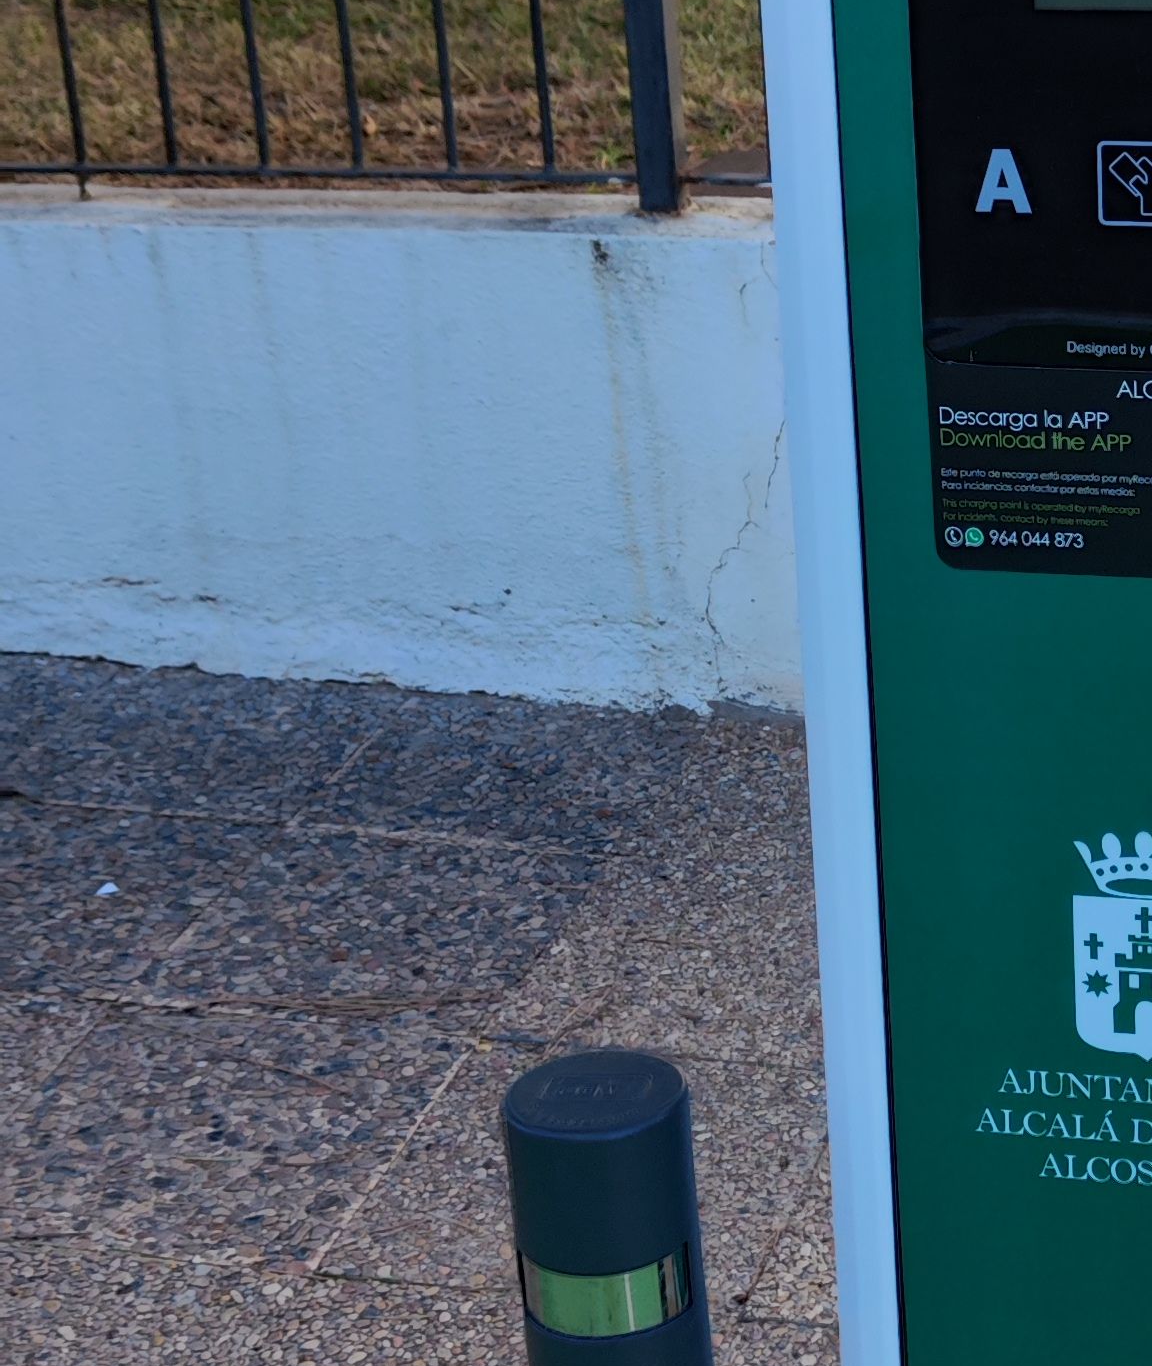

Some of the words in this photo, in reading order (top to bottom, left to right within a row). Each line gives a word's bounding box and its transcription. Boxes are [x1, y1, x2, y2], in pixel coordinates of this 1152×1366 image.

[973, 146, 1033, 215] A
[1066, 340, 1127, 357] Designed
[1130, 342, 1146, 359] by
[938, 406, 1039, 432] Descarga
[1043, 409, 1063, 429] la
[1067, 411, 1110, 430] APP
[938, 428, 1046, 450] Download
[1050, 431, 1086, 451] the
[1090, 433, 1132, 452] APP
[940, 467, 959, 478] Este
[960, 469, 987, 479] punto
[987, 469, 1001, 479] de
[1001, 471, 1039, 482] recarga
[1060, 473, 1101, 483] operado
[1101, 475, 1118, 485] por
[941, 480, 963, 490] Para
[963, 481, 1013, 492] incidencias
[1014, 483, 1059, 494] contactar
[1059, 485, 1076, 495] por
[942, 497, 958, 508] This
[958, 498, 998, 511] charging
[1031, 502, 1074, 513] operated
[1074, 503, 1087, 515] by
[988, 529, 1019, 547] 964
[1020, 530, 1051, 547] 044
[1053, 531, 1085, 549] 873
[975, 1107, 1122, 1143] ALCALÁ
